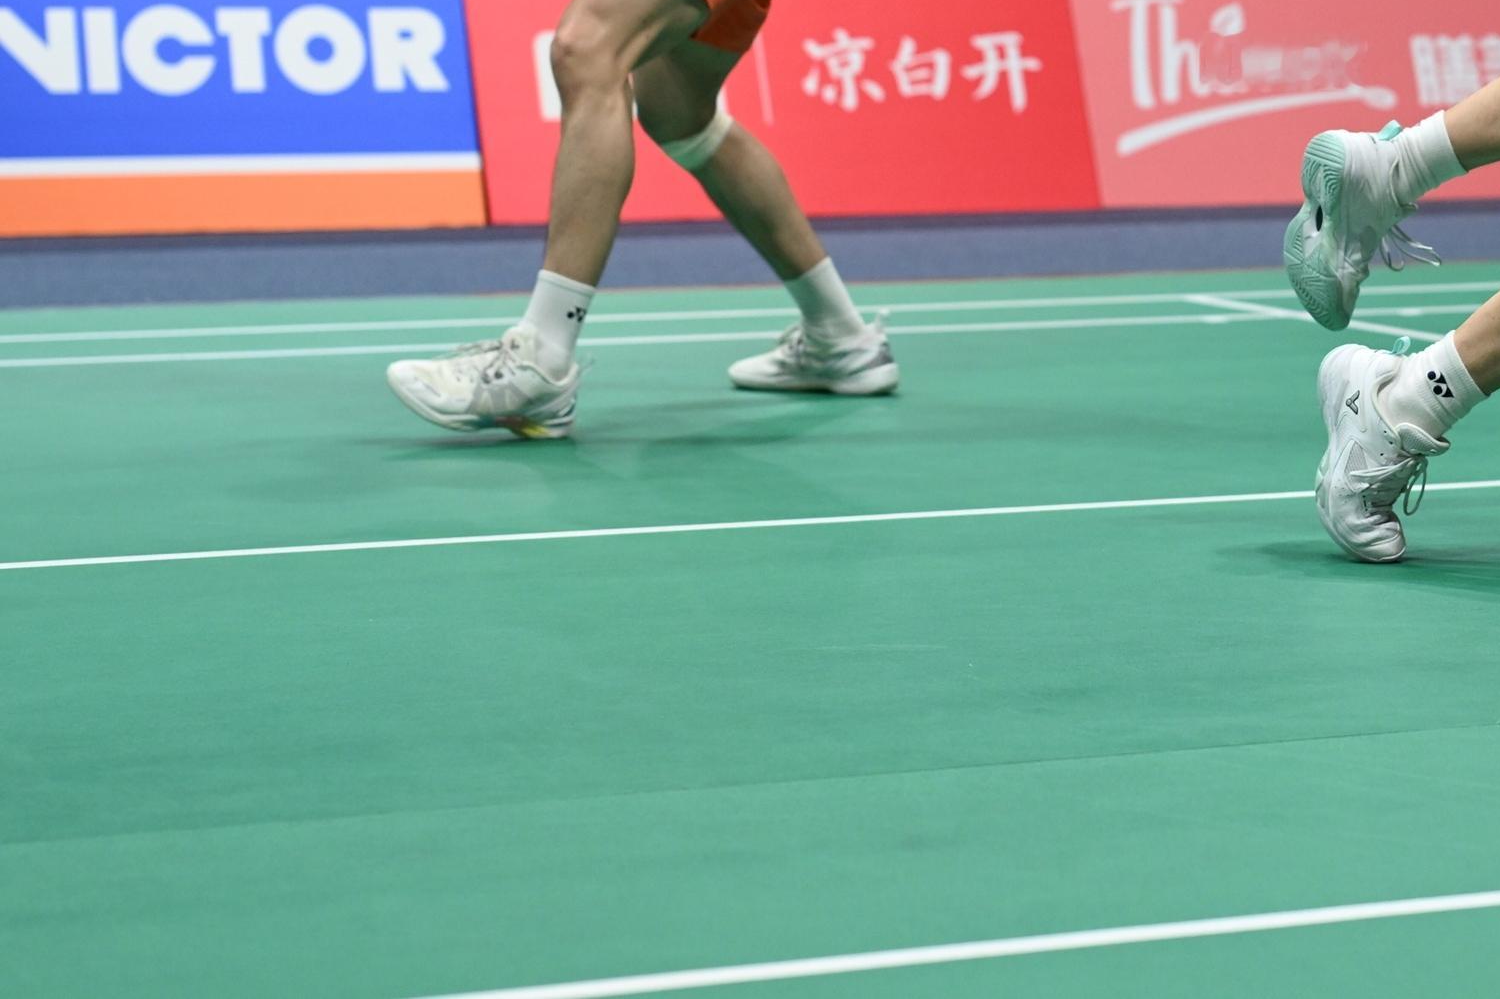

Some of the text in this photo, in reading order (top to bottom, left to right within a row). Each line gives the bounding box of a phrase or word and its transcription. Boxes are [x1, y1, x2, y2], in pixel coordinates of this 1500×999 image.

[0, 4, 450, 95] VICTOR
[801, 27, 1043, 113] 凉白开
